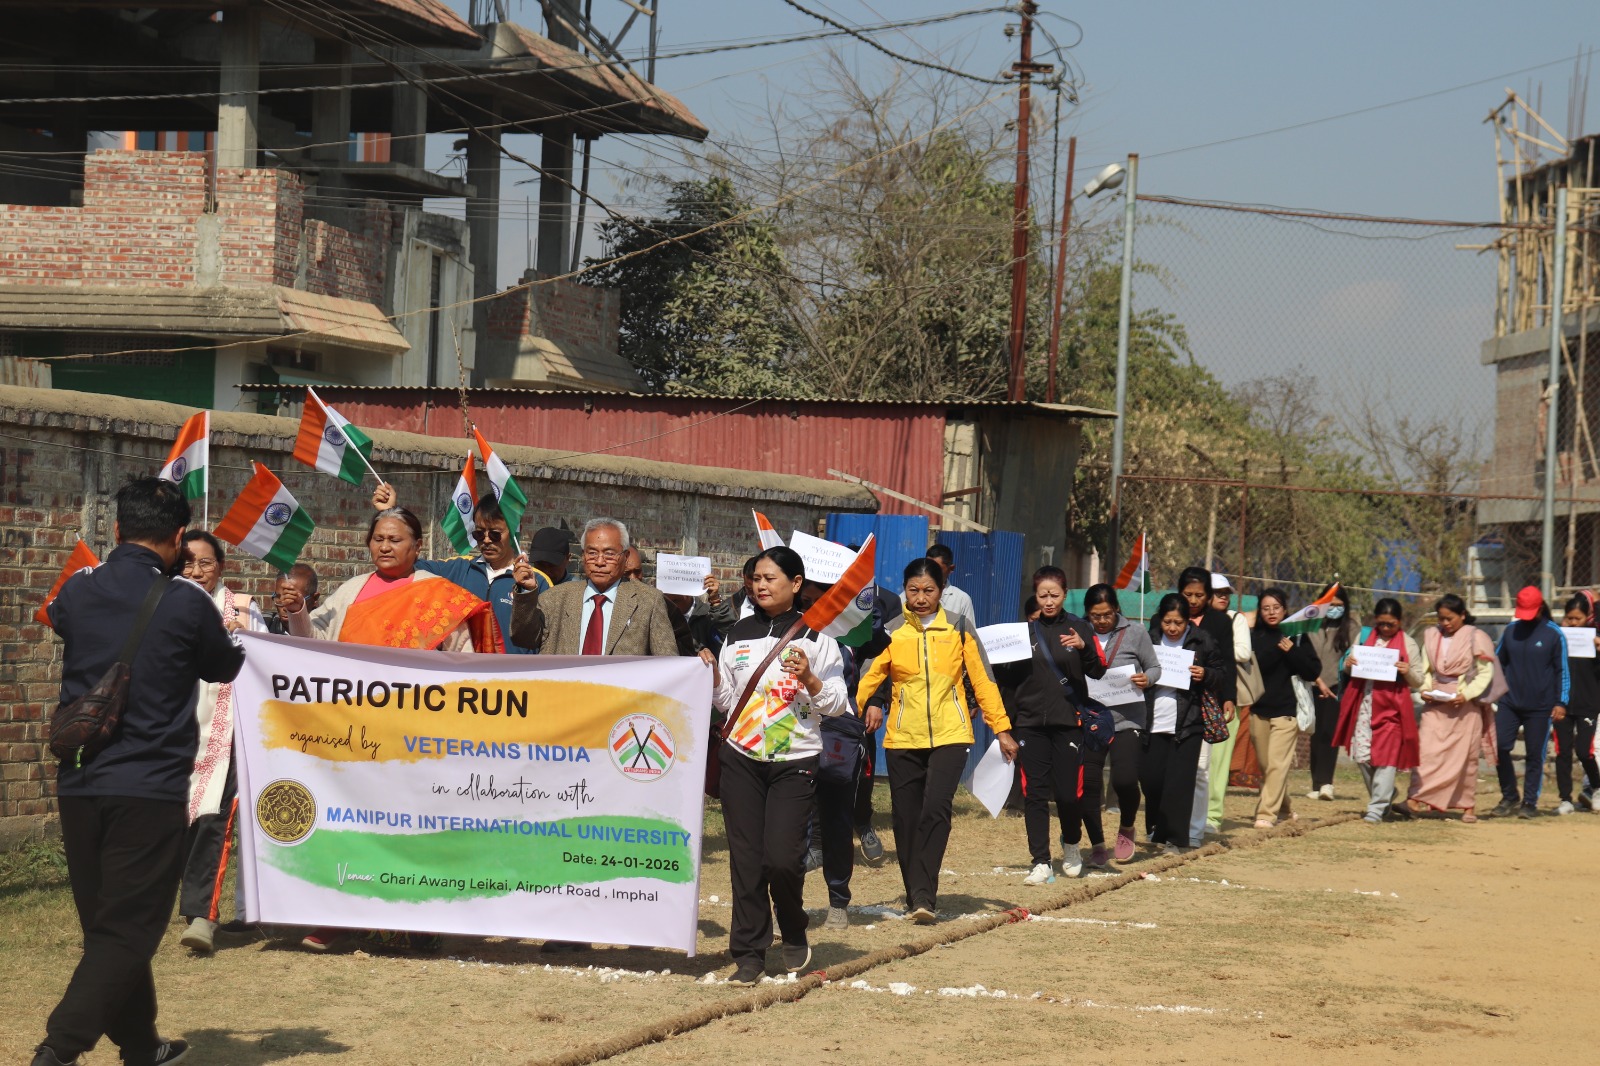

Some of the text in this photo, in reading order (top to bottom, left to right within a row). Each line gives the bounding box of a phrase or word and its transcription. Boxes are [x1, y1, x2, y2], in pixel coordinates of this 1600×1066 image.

[802, 554, 843, 569] ACRIFICED
[272, 673, 529, 718] PATRIOTIC RUN
[290, 724, 381, 760] organised by
[403, 735, 590, 763] VETERANS INDIA
[432, 773, 595, 810] in collaboration with
[326, 806, 691, 847] MANIPUR INTERNATIONAL UNIVERSITY
[563, 851, 680, 872] Date: 24-01-2026
[337, 862, 375, 886] Venue:
[379, 873, 416, 886] Ghari
[418, 874, 466, 891] Awang
[469, 878, 512, 892] Leikai,
[515, 881, 563, 895] Airport
[566, 884, 600, 898] Road
[612, 888, 658, 903] Imphal
